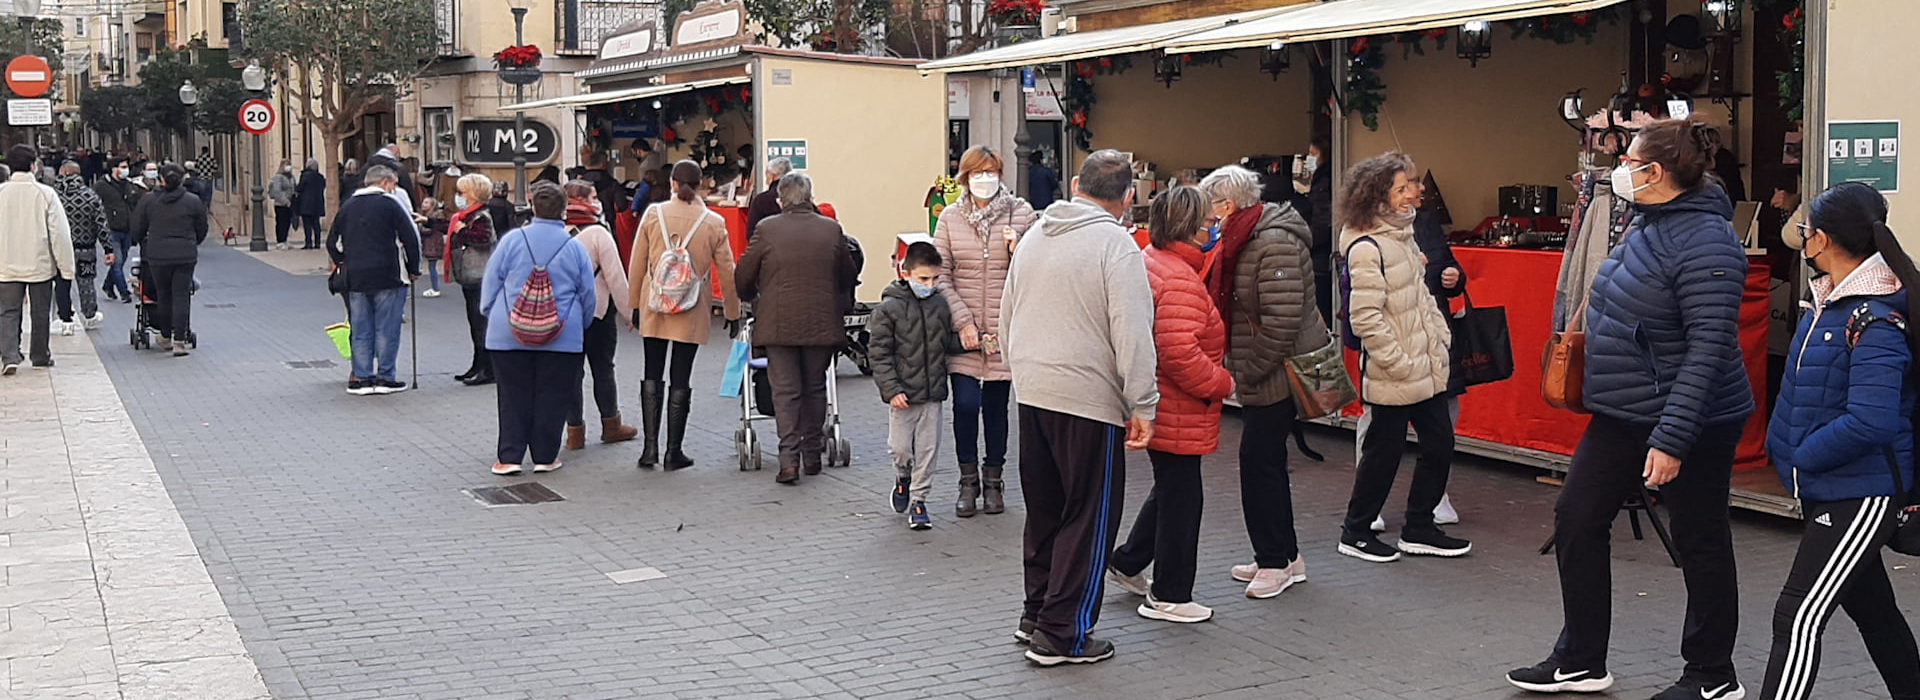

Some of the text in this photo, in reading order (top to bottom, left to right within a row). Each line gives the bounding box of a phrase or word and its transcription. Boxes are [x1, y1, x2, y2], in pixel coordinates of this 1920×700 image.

[247, 111, 267, 122] 20
[467, 129, 480, 153] M2
[494, 128, 538, 153] M2
